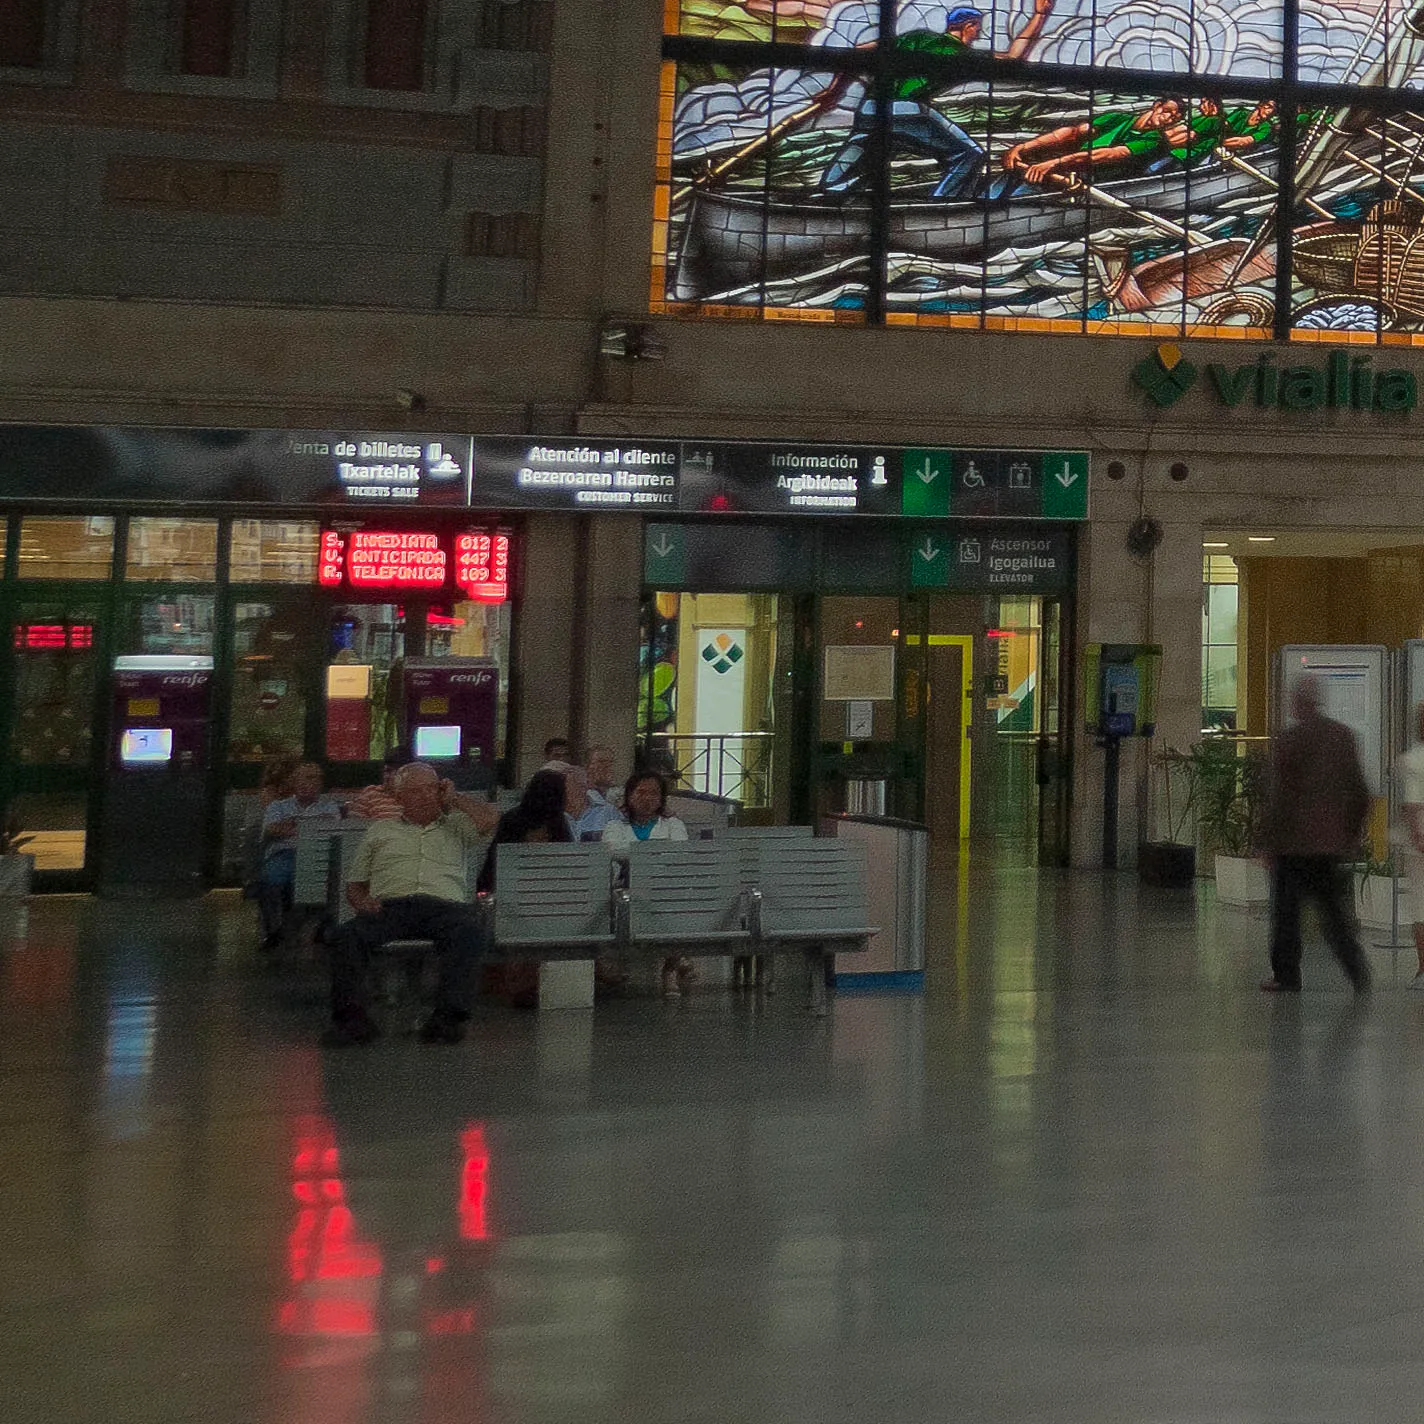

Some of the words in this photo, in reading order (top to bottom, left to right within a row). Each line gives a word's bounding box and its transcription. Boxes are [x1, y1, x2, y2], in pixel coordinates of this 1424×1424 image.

[335, 441, 357, 456] de
[360, 441, 421, 458] billetes
[529, 447, 600, 463] Atención
[604, 448, 620, 464] al
[623, 449, 676, 465] cliente
[771, 454, 858, 468] Información
[340, 463, 420, 480] Txartelak
[519, 467, 612, 485] Bezeroaren
[616, 471, 674, 486] Harrera
[777, 474, 858, 492] Argibideak
[355, 534, 438, 549] INMEDIATA
[991, 538, 1051, 551] Ascensor
[352, 550, 446, 564] ANTICIPADA
[990, 556, 1056, 570] Igogailua
[352, 565, 445, 580] TELEFONICA
[162, 673, 209, 689] renfe
[450, 671, 493, 687] renfe
